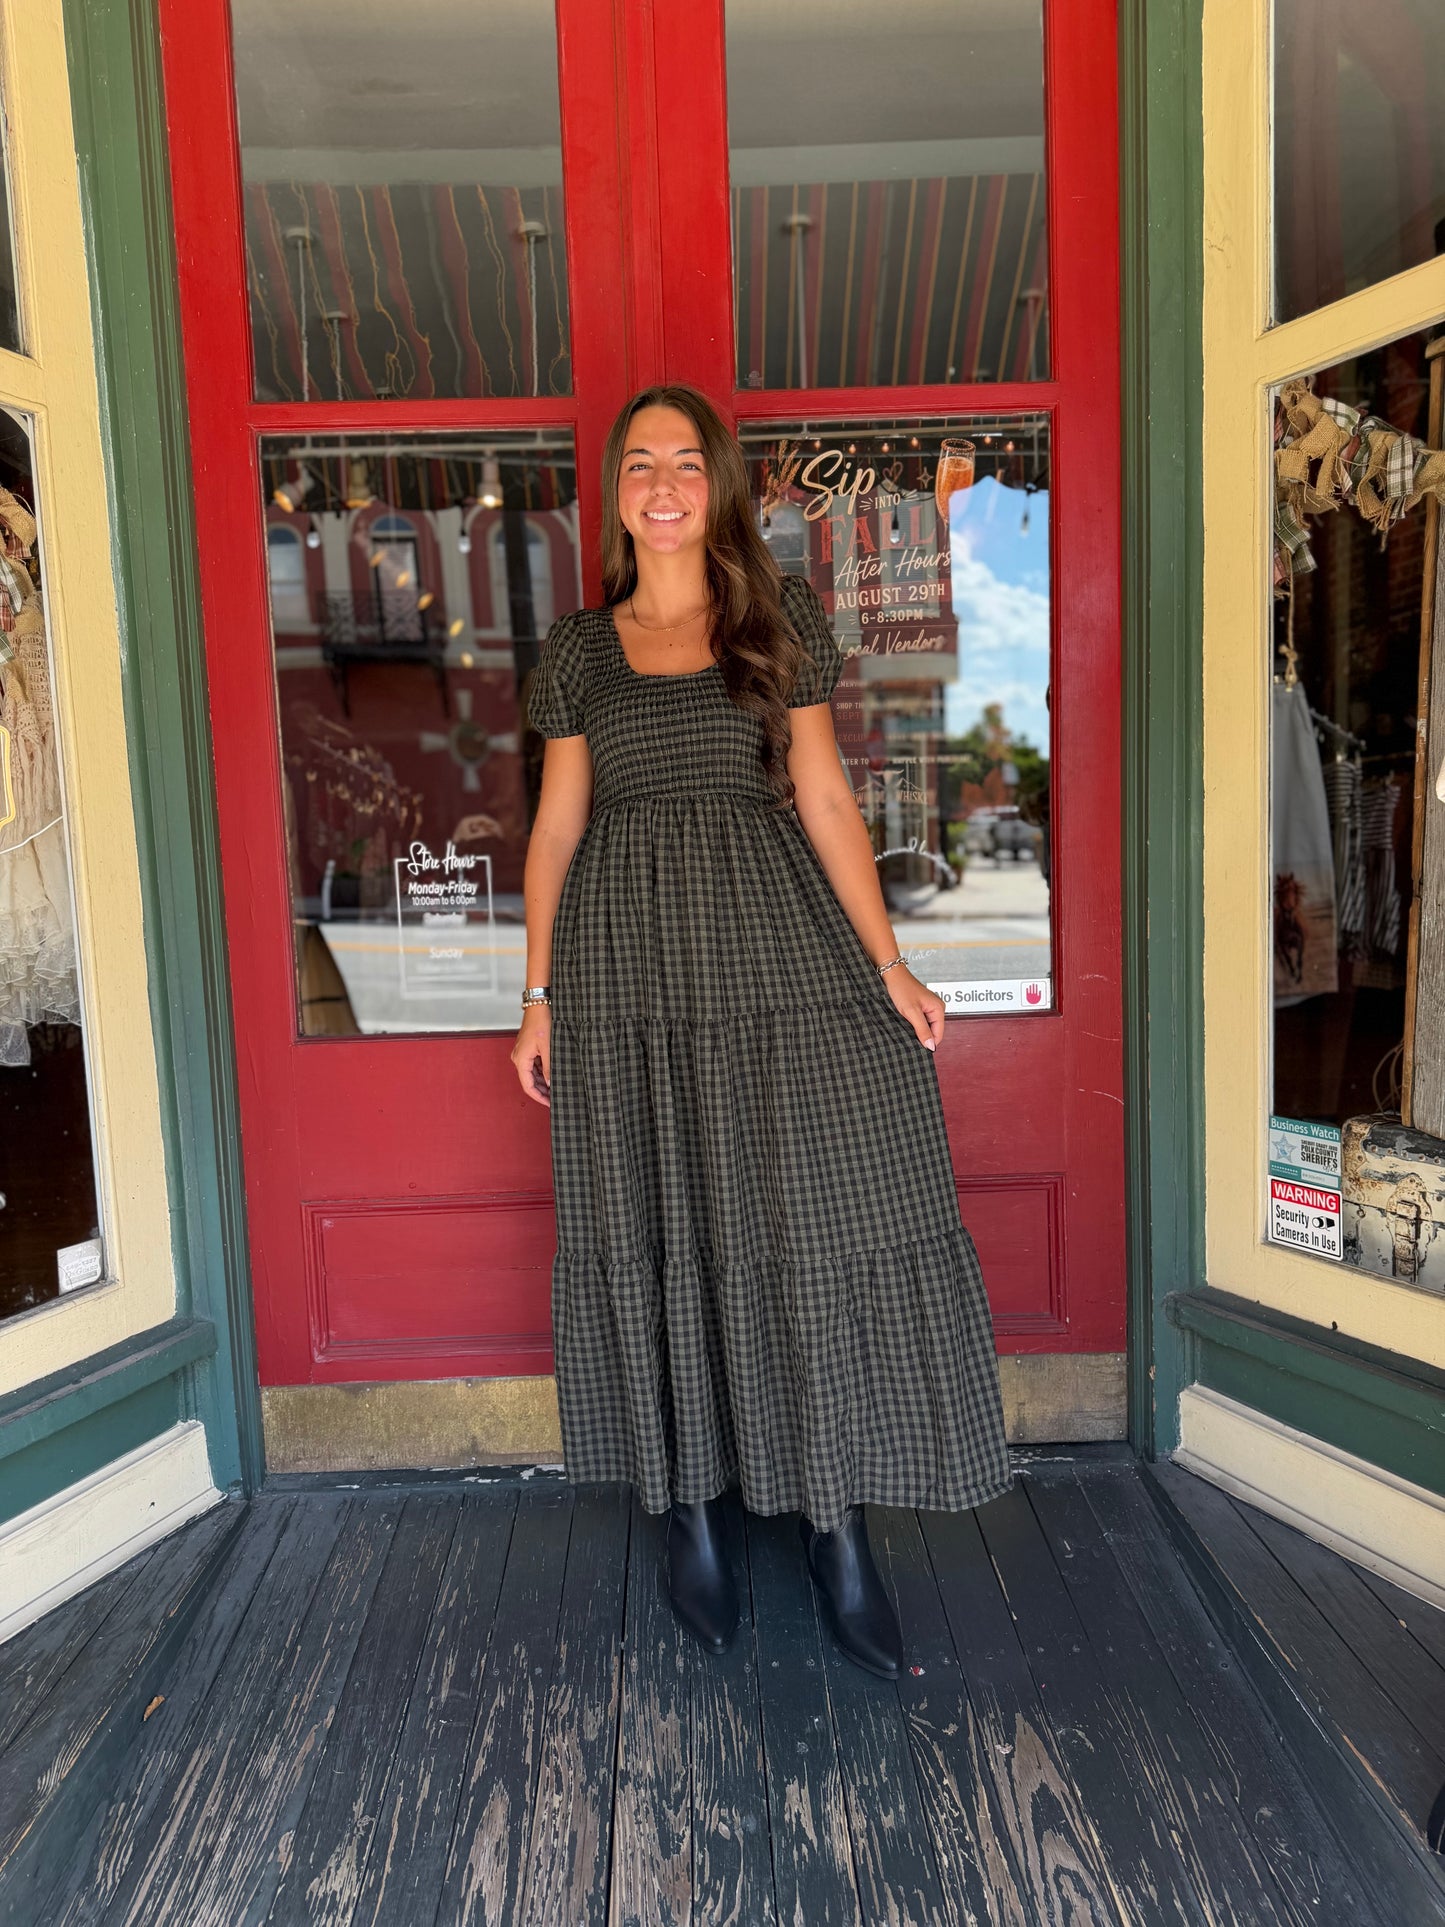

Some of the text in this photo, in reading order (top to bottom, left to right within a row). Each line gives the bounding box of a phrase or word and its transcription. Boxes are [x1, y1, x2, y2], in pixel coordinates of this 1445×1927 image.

[802, 450, 875, 522] Sip
[874, 493, 901, 510] INTO
[818, 505, 937, 566] FALL
[834, 547, 952, 588] After Hours
[836, 583, 945, 610] AUGUST 29TH
[861, 608, 924, 625] 6-8:30PM
[838, 629, 946, 661] Local Vendors
[836, 702, 853, 710] SHOP
[839, 758, 859, 767] NTER
[407, 840, 477, 876] Store Hours
[408, 881, 478, 896] Monday-Friday
[441, 896, 449, 906] to
[450, 895, 477, 906] 600pm
[935, 989, 1014, 1003] No Solicitors
[1271, 1117, 1339, 1141] Business Watch
[1315, 1147, 1338, 1159] COUNTY
[1274, 1183, 1337, 1211] WARNING
[1275, 1204, 1310, 1229] Security
[1275, 1222, 1336, 1251] Cameras In Use
